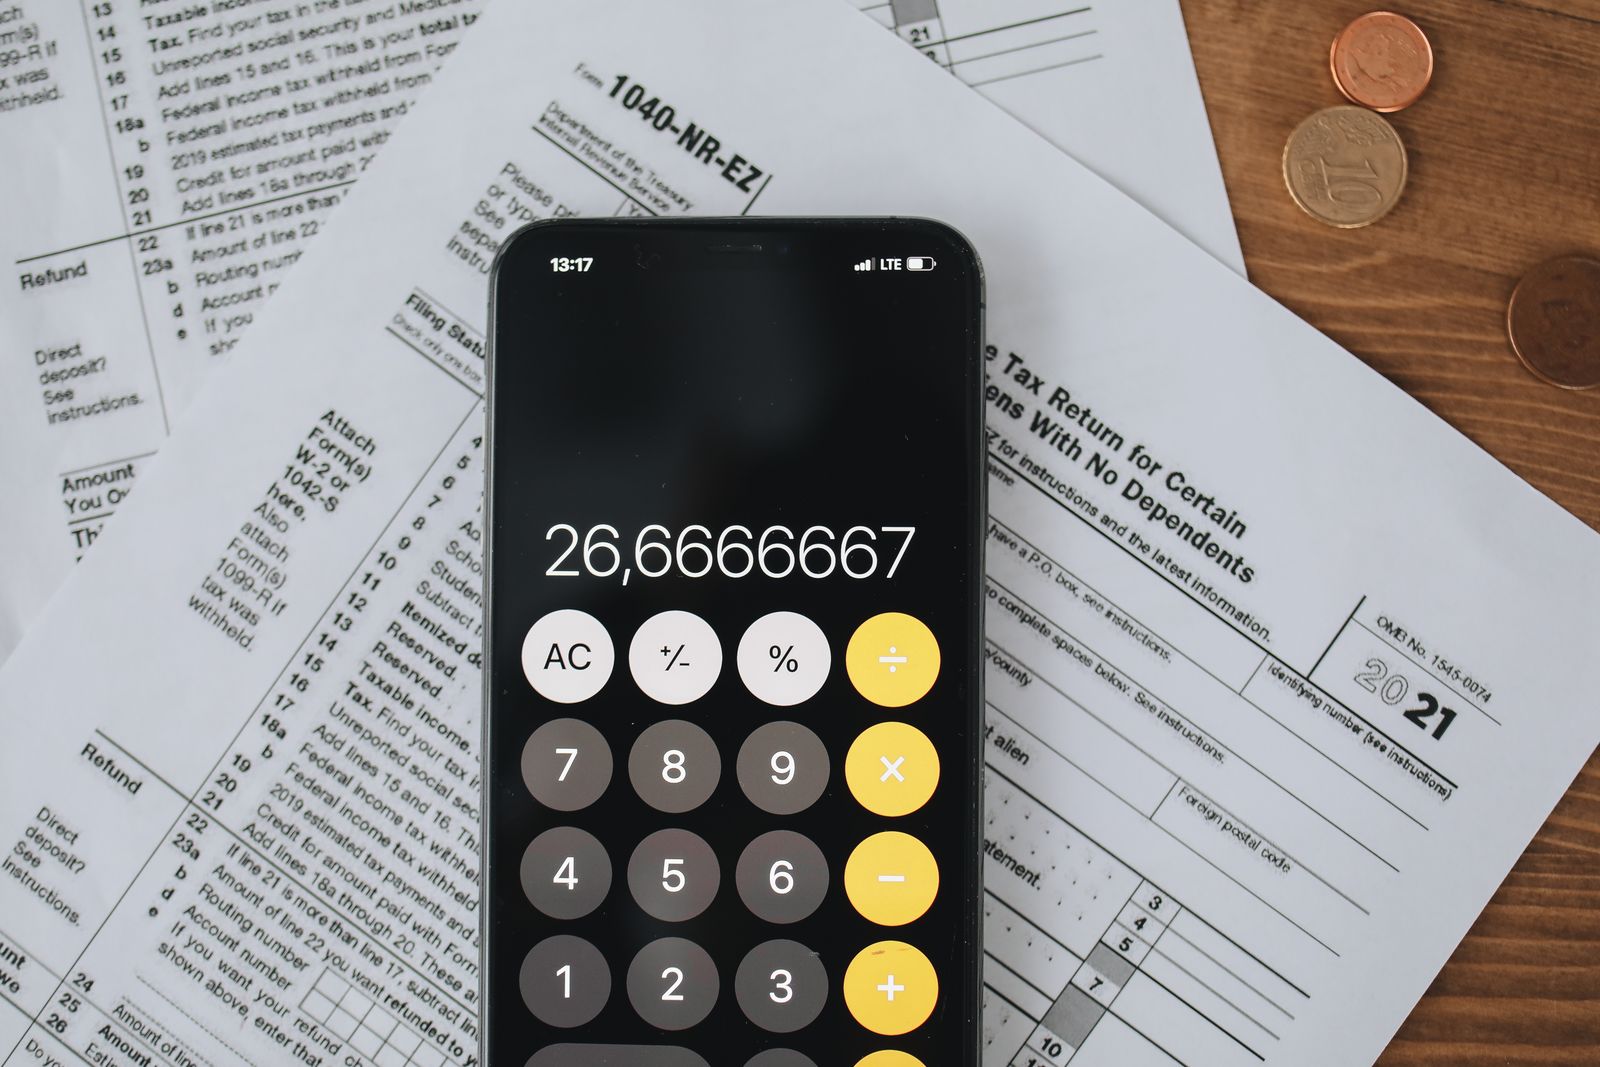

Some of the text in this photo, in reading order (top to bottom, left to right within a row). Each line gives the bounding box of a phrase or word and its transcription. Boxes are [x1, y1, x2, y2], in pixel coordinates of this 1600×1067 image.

[909, 26, 930, 43] 21
[608, 75, 762, 193] 1040-NR-EZ
[547, 102, 612, 151] Department
[649, 171, 692, 209] Treasury
[128, 150, 314, 204] 20 Credit for amount
[488, 185, 505, 199] or
[500, 162, 552, 206] Please
[475, 200, 502, 224] See
[143, 221, 317, 275] 23a Amount of line 22
[550, 257, 594, 273] 13:17
[880, 258, 902, 271] LTE
[20, 261, 87, 290] Refund
[167, 264, 258, 294] b Routing
[173, 286, 262, 318] d Account
[405, 293, 484, 358] Filing Statu
[35, 344, 81, 365] Direct
[40, 357, 105, 384] deposit?
[43, 390, 73, 404] See
[48, 394, 142, 423] instructions.
[320, 410, 375, 455] Attach
[1004, 352, 1246, 539] Tax Return for Certain
[296, 444, 349, 491] W-2 or
[308, 426, 371, 482] Form(s)
[63, 464, 134, 493] Amount
[284, 466, 338, 512] 1042-S
[1030, 410, 1081, 461] With
[1085, 452, 1117, 484] No
[1121, 478, 1254, 583] Dependents
[64, 497, 101, 513] You
[254, 502, 288, 532] Also
[267, 482, 305, 521] here.
[241, 523, 288, 562] attach
[545, 523, 916, 587] 26,6666667
[997, 439, 1269, 642] for instructions and the latest information.
[227, 537, 286, 589] Form(s)
[202, 576, 259, 625] tax was
[217, 558, 287, 615] 1099-R if
[988, 524, 1170, 662] have a P.O. box, see instructions.
[189, 595, 254, 651] withheld.
[348, 593, 456, 680] 12 Reserved.
[543, 642, 592, 671] AC
[769, 645, 799, 673] %
[1377, 616, 1491, 702] OMB No. 1545-0074
[319, 633, 469, 754] 14 Taxable income.
[997, 593, 1223, 763] complete spaces below. See instructions.
[304, 653, 466, 779] 15 Tax. Find your tax
[1268, 662, 1452, 801] Identifying number (see instructions)
[81, 743, 142, 794] Refund
[555, 747, 578, 782] 7
[661, 749, 687, 784] 8
[770, 750, 796, 785] 9
[995, 736, 1029, 765] alien
[36, 807, 78, 845] Direct
[233, 754, 445, 920] 19 2019 estimated tax payments
[1178, 786, 1290, 873] Foreign postal code
[13, 841, 40, 867] See
[26, 827, 85, 873] deposit?
[215, 773, 441, 948] 20 Credit for amount paid with
[2, 855, 78, 926] instructions.
[552, 856, 579, 890] 4
[662, 858, 686, 893] 5
[769, 859, 794, 895] 6
[175, 865, 309, 971] b Routing number
[1149, 896, 1162, 910] 3
[161, 888, 292, 990] d Account number
[1134, 917, 1146, 930] 4
[172, 833, 463, 1057] 23a Amount of line 22 you want refunded to
[1119, 937, 1133, 951] 5
[73, 973, 94, 992] 24
[556, 964, 571, 999] 1
[661, 966, 684, 1001] 2
[769, 969, 793, 1004] 3
[1090, 977, 1102, 989] 7
[46, 1013, 67, 1033] 26
[59, 993, 151, 1066] 25 Amount
[1042, 1039, 1061, 1057] 10
